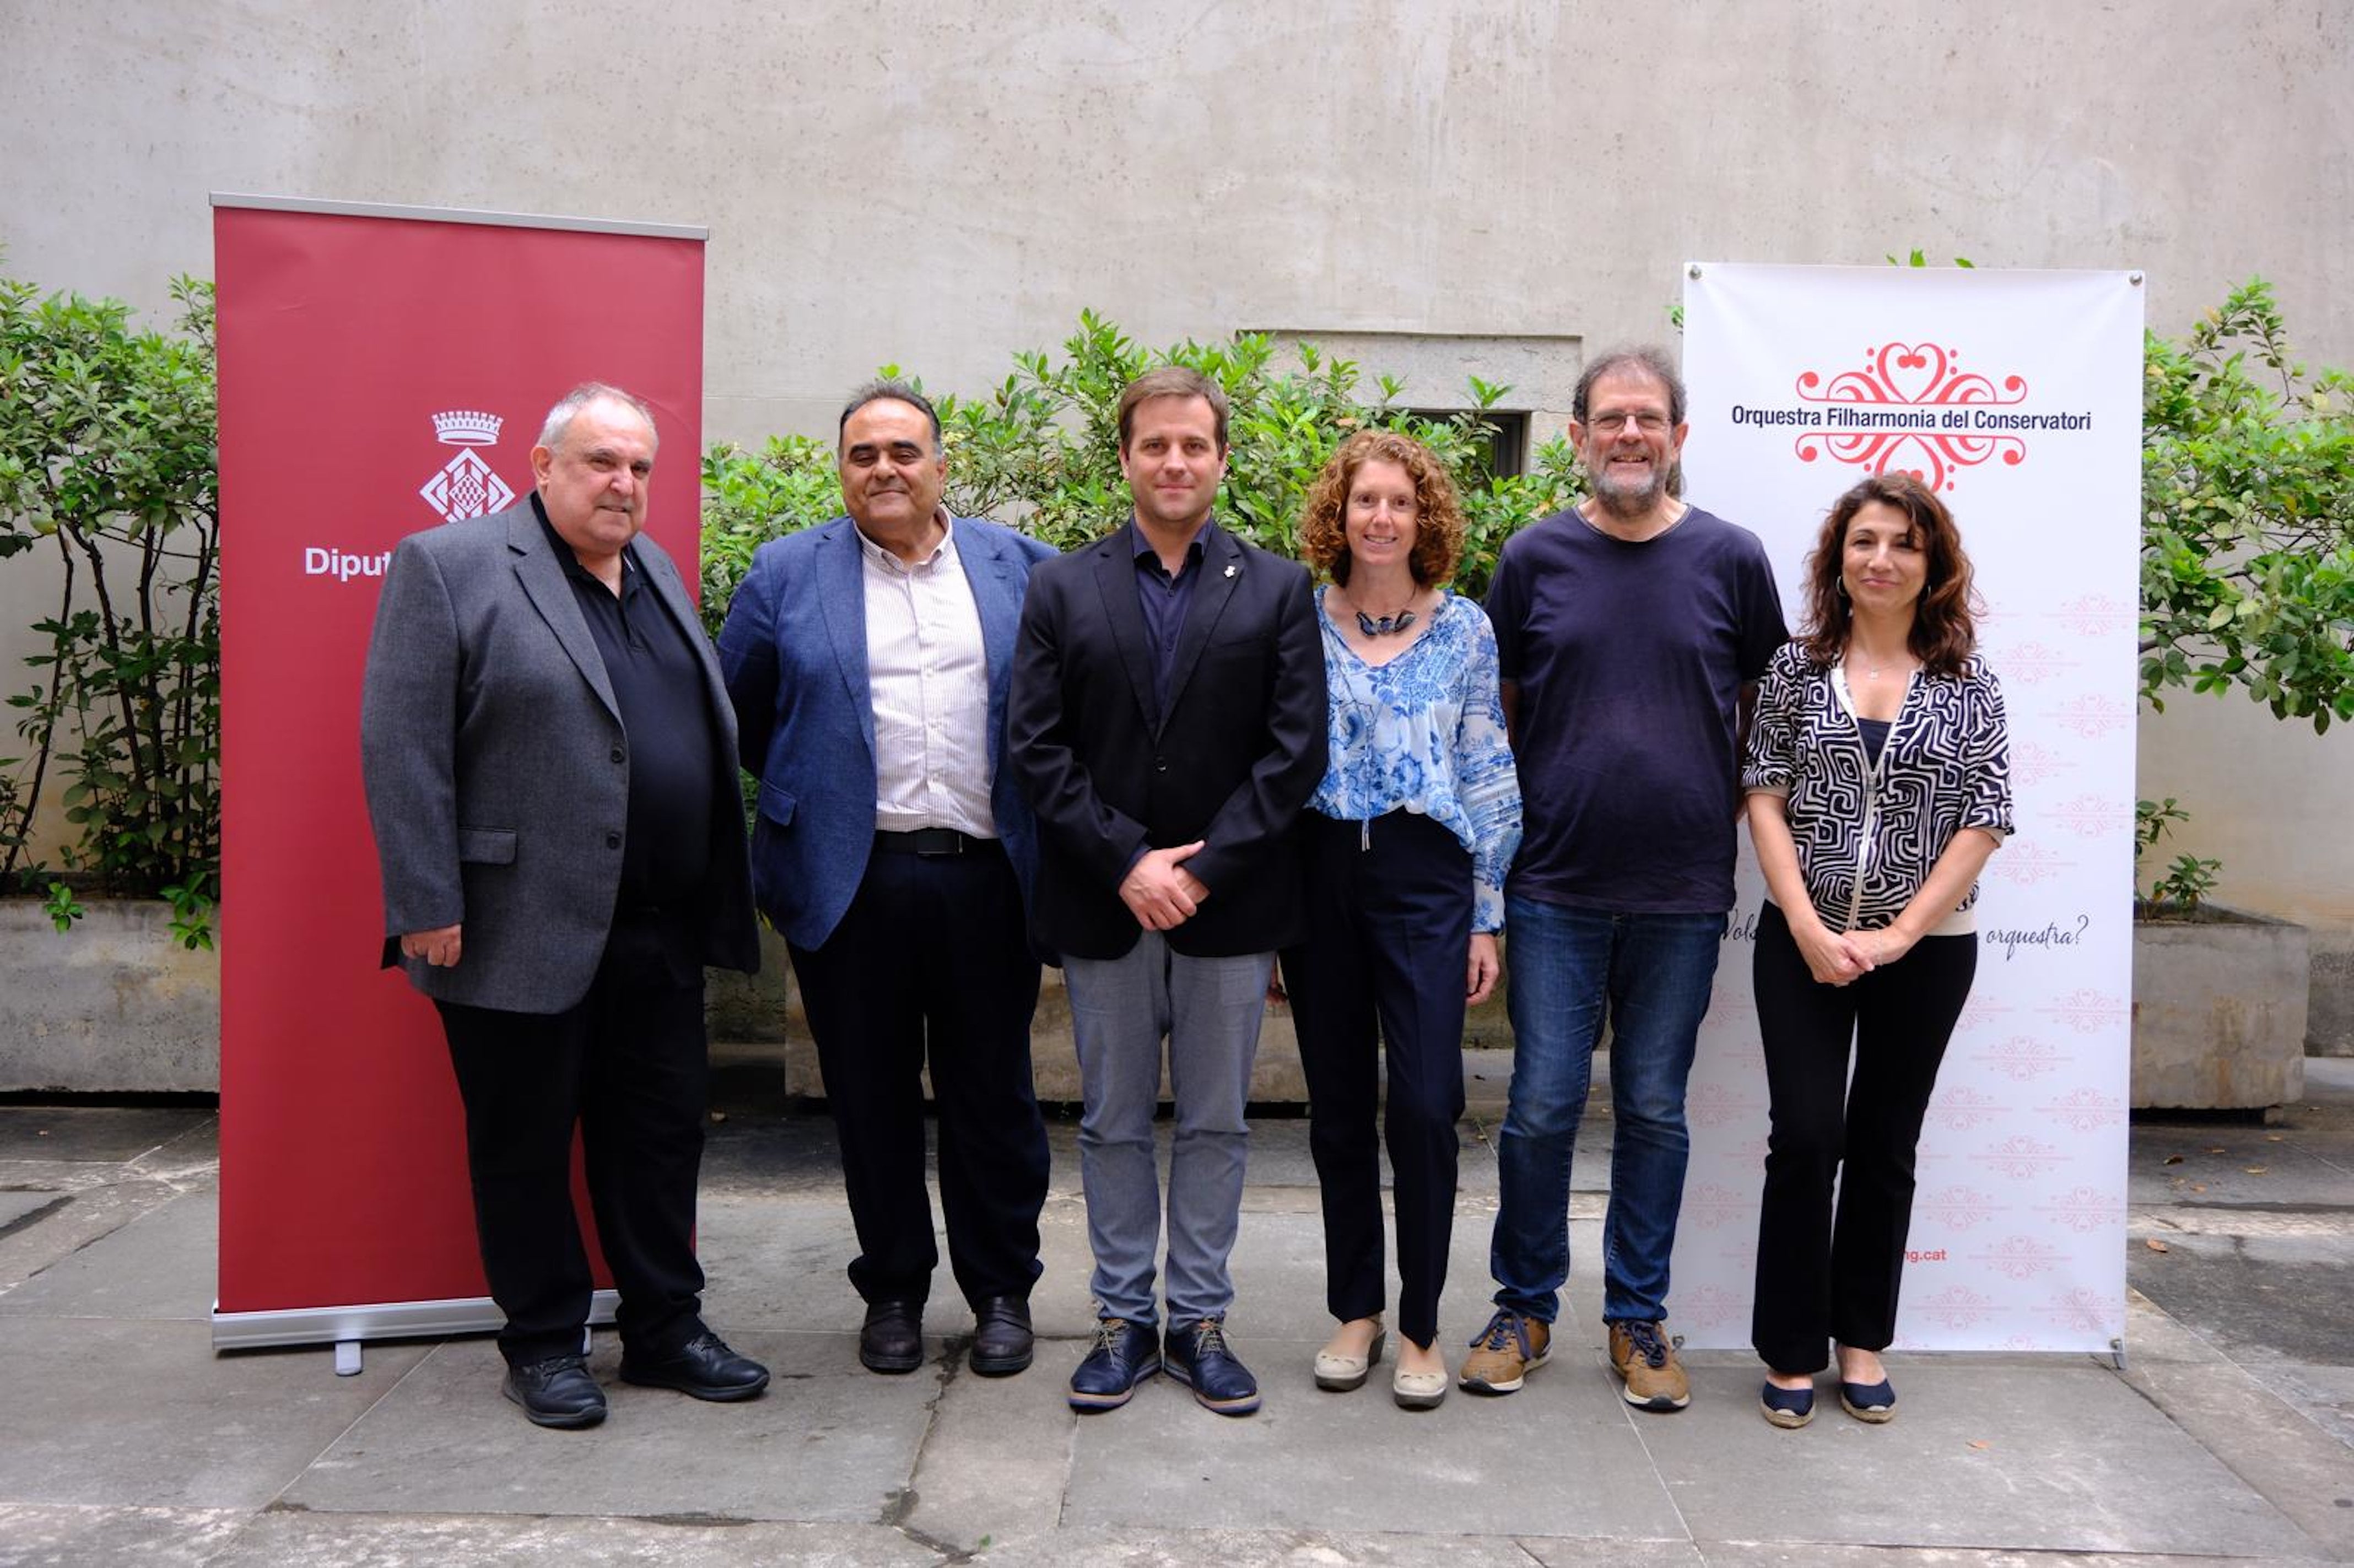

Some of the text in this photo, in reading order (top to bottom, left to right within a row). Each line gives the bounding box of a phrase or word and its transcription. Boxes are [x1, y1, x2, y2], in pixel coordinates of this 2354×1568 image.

[1732, 405, 2091, 430] Orquestra Filharmonia del Conservatori
[1986, 915, 2088, 961] orquestra?
